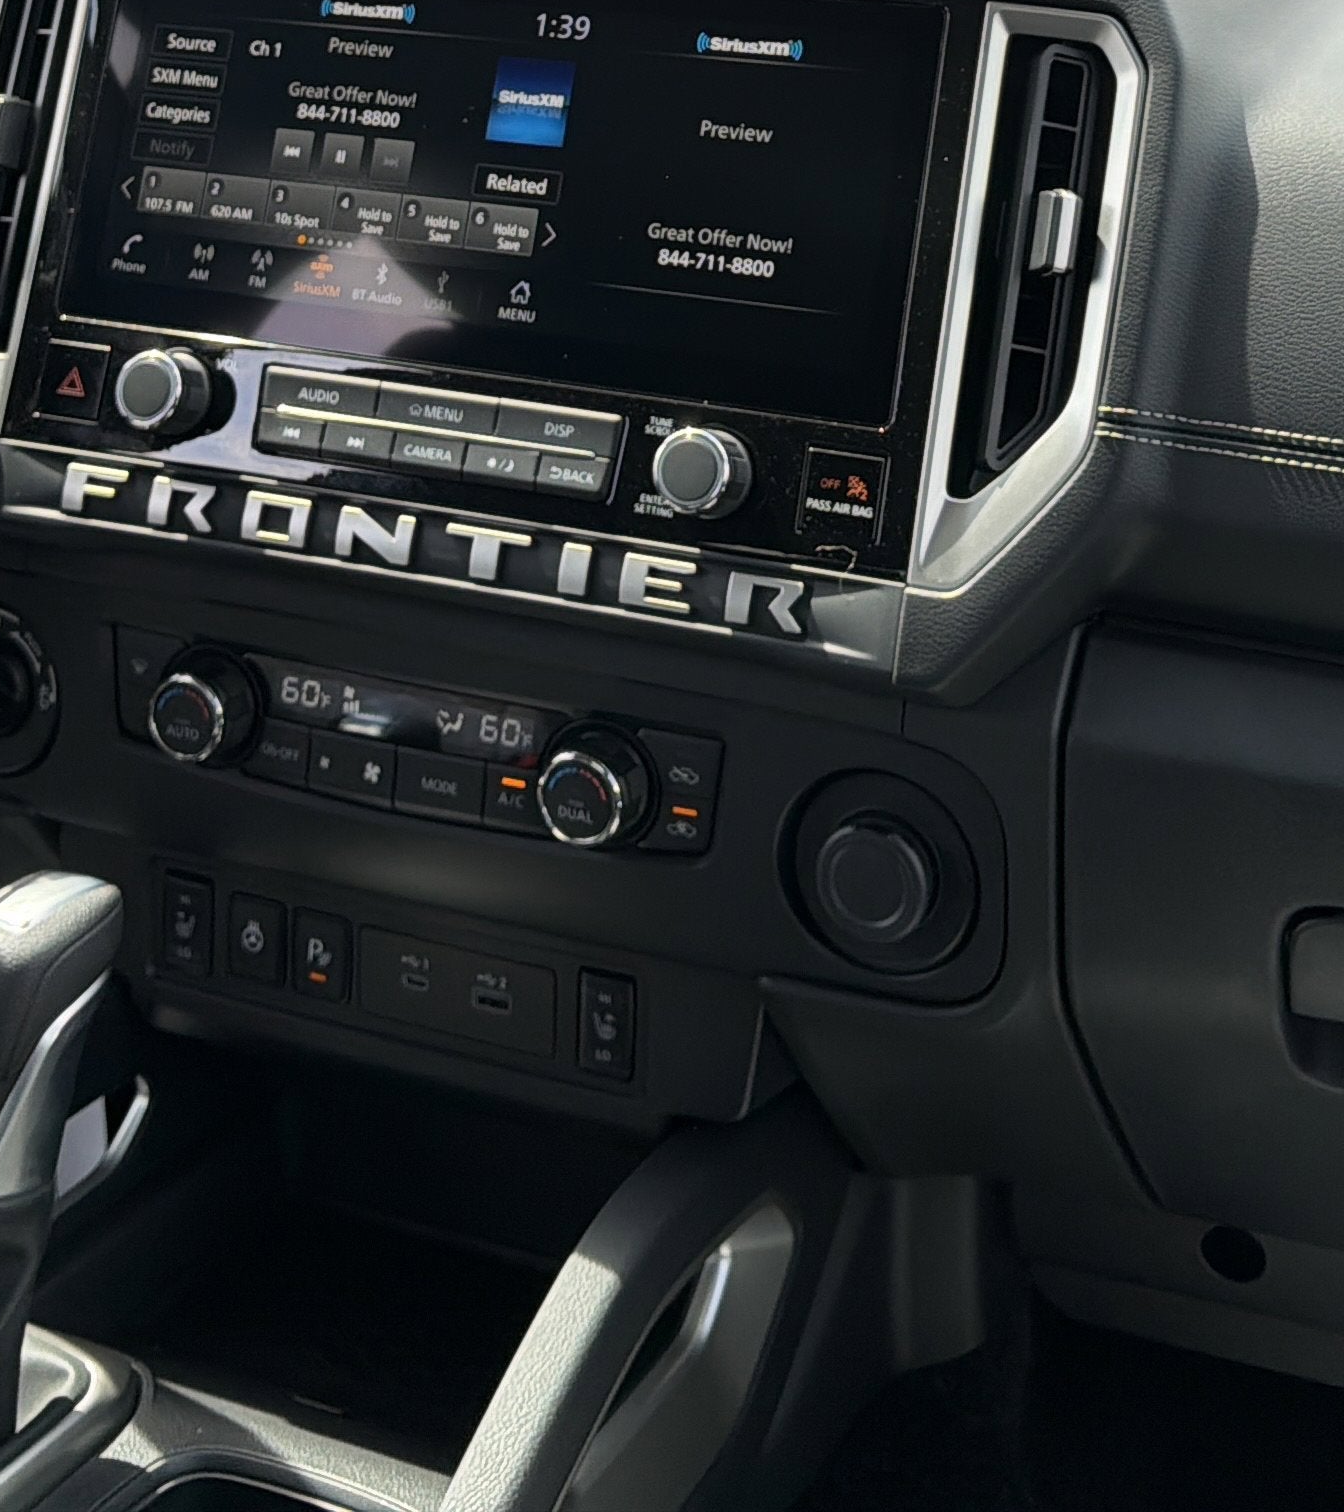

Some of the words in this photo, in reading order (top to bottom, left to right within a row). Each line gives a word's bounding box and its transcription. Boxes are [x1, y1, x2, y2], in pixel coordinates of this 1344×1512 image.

[536, 12, 590, 40] 1:39
[167, 32, 216, 53] Source
[249, 39, 271, 57] Ch
[275, 41, 282, 58] 1
[327, 37, 394, 58] Preview
[152, 67, 181, 86] SXM
[183, 70, 218, 88] Menu
[288, 81, 329, 101] Great
[332, 84, 373, 105] Offer
[375, 89, 418, 108] Now!
[145, 101, 211, 125] Categories
[296, 103, 401, 128] 844-711-8800
[699, 119, 774, 143] Preview
[149, 140, 196, 159] Notify
[485, 173, 548, 196] Related
[145, 197, 172, 212] 107.5
[175, 201, 194, 214] FM
[340, 196, 349, 209] 4
[407, 204, 416, 217] 5
[210, 204, 232, 218] 620
[232, 207, 253, 221] AM
[293, 214, 320, 229] Spot
[358, 208, 381, 222] Hold
[381, 210, 393, 223] to
[475, 211, 484, 225] 6
[360, 222, 384, 236] Save
[424, 215, 448, 229] Hold
[449, 218, 460, 231] to
[492, 223, 518, 237] Hold
[518, 226, 530, 239] to
[428, 230, 452, 244] Save
[496, 237, 521, 252] Save
[647, 222, 694, 244] Great
[698, 227, 744, 249] Offer
[746, 233, 793, 254] Now!
[111, 257, 147, 275] Phone
[657, 248, 775, 278] 844-711-8800
[188, 268, 210, 281] AM
[247, 275, 267, 288] FM
[368, 290, 403, 306] Audio
[497, 306, 536, 323] MENU
[297, 387, 340, 405] AUDIO
[423, 404, 464, 423] MENU
[544, 422, 575, 437] DISP
[403, 443, 452, 463] CAMERA
[562, 467, 596, 485] BACK
[819, 477, 842, 489] OFF
[806, 497, 832, 512] PASS
[832, 501, 851, 515] AIR
[851, 504, 873, 519] BAG
[61, 461, 804, 635] FRONTIER
[557, 803, 595, 824] DUAL
